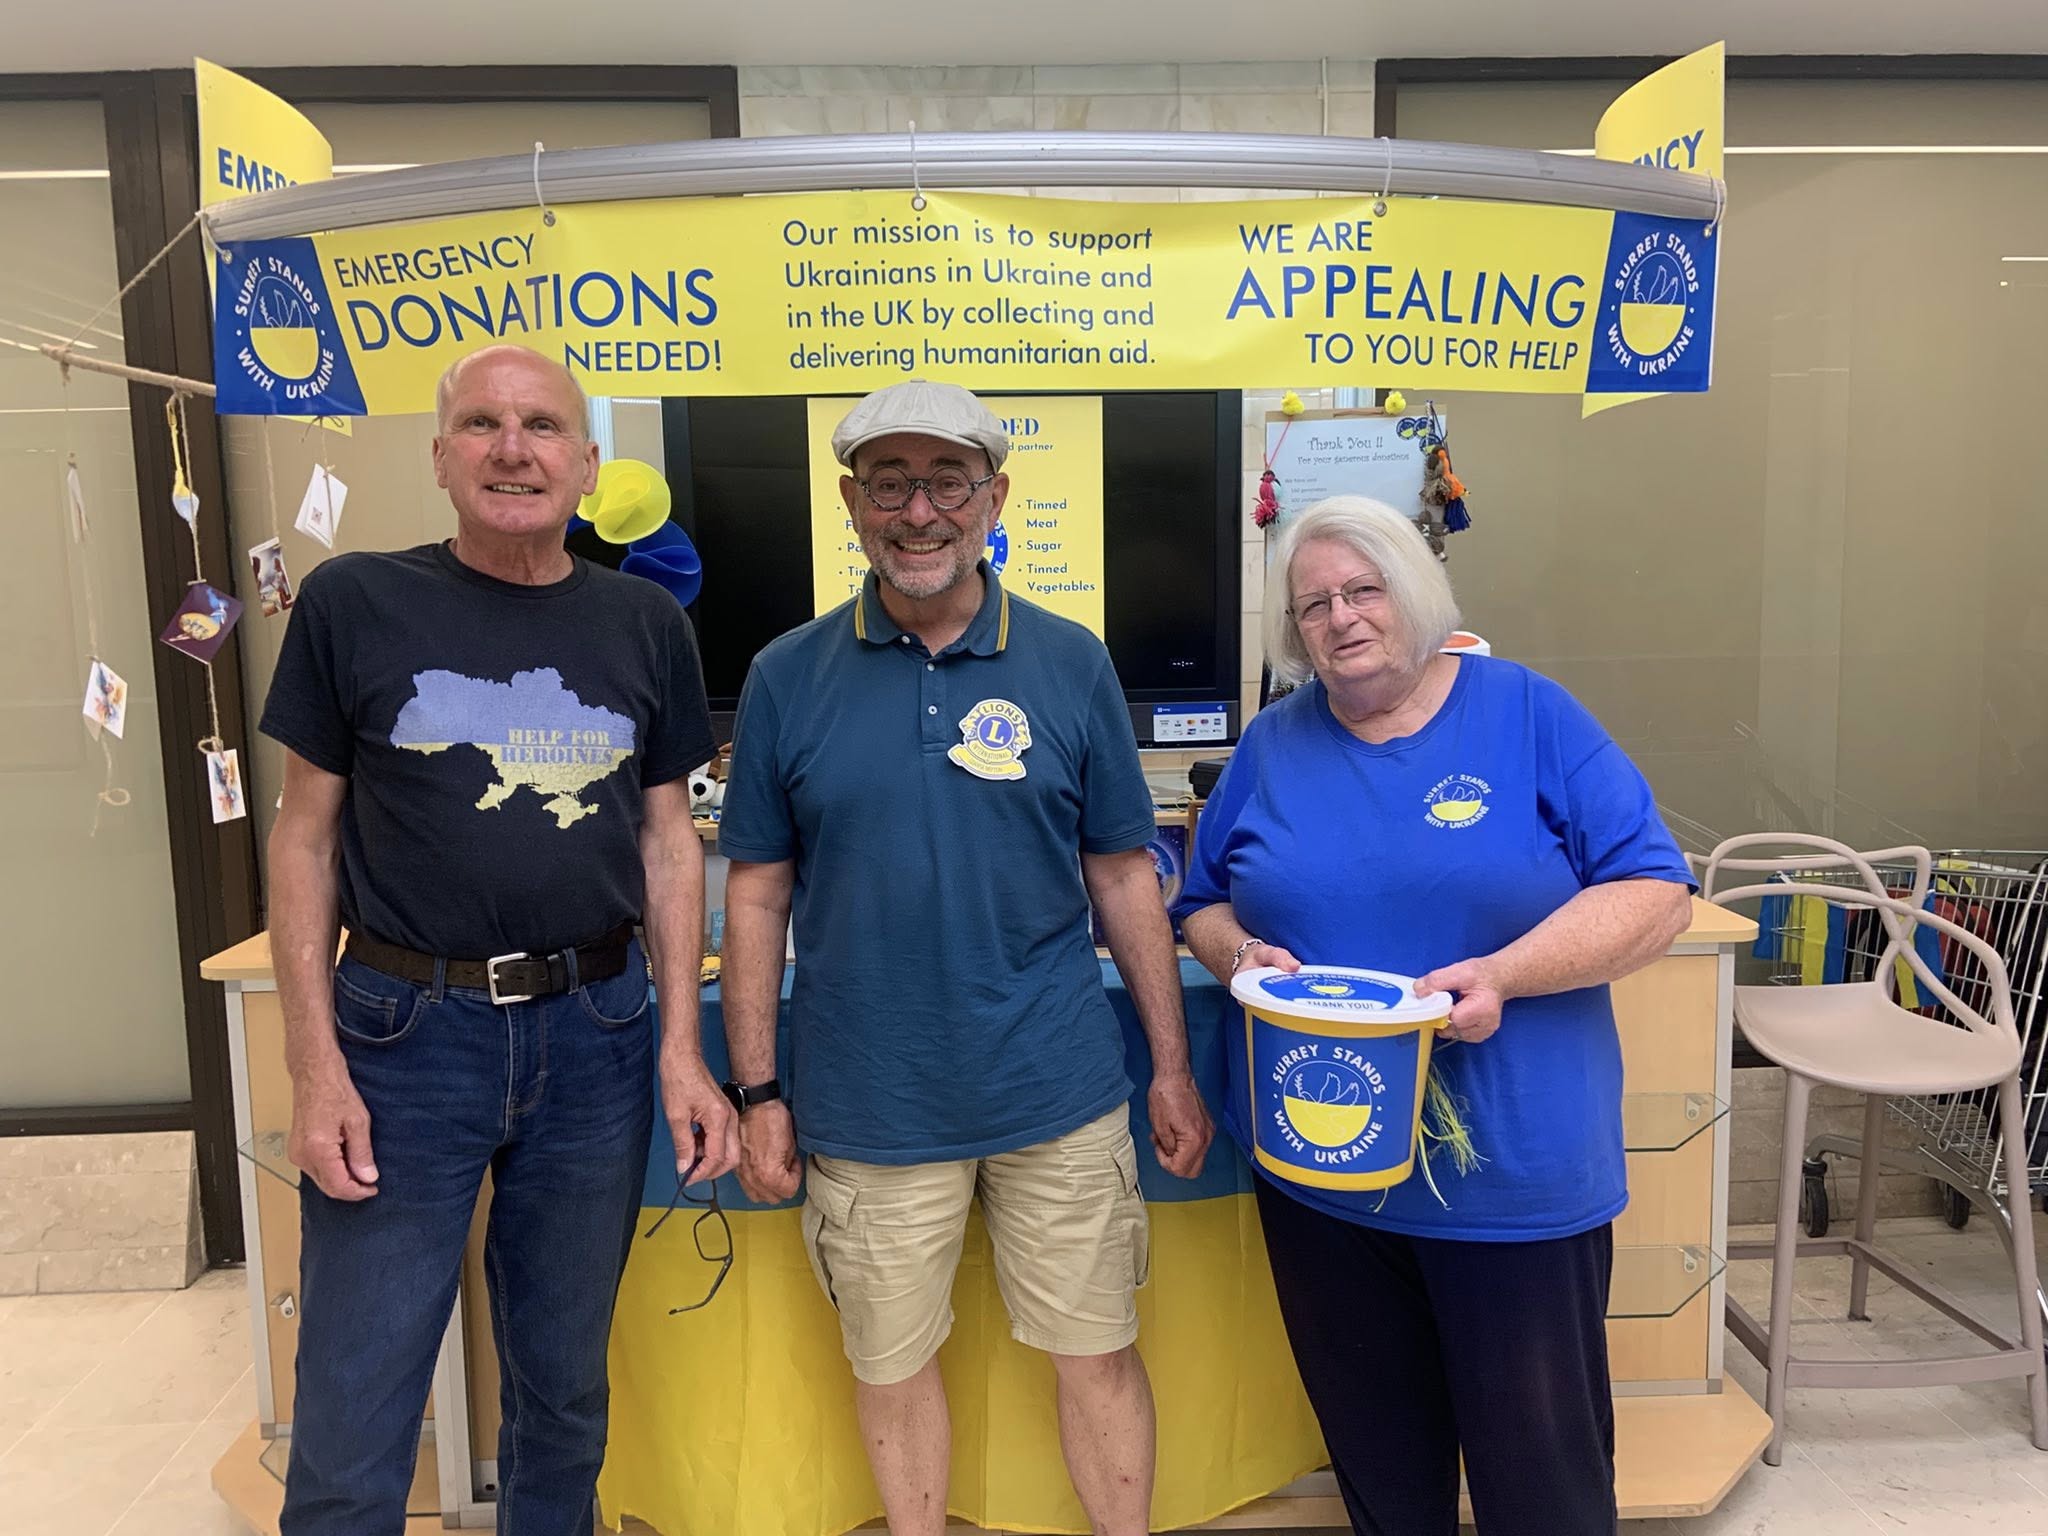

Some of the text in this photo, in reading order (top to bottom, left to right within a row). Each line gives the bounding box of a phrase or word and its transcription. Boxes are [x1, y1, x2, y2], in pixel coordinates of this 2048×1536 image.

[783, 217, 1153, 256] Our mission is to support
[1239, 221, 1373, 254] WE ARE
[333, 232, 536, 288] EMERGENCY
[785, 257, 1152, 288] Ukrainians in Ukraine and
[1615, 232, 1699, 293] SURREY STANDS
[234, 256, 321, 317] SURREY STANDS
[1225, 264, 1586, 329] APPEALING
[347, 268, 718, 351] DONATIONS
[787, 298, 1154, 331] in the UK by collecting and
[565, 340, 722, 372] NEEDED!
[790, 338, 1156, 371] delivering humanitarian aid.
[1305, 333, 1579, 371] TO YOU FOR HELP
[1608, 323, 1695, 376] WITH UKRAINE
[237, 347, 334, 400] WITH UKRAINE
[1018, 443, 1054, 452] partner
[1308, 437, 1343, 451] Thank
[1347, 437, 1372, 449] You
[1026, 499, 1067, 510] Tinned
[1026, 519, 1058, 528] Meat
[1026, 540, 1062, 552] Sugar
[1027, 563, 1068, 574] Tinned
[1027, 581, 1096, 594] Vegetables
[982, 703, 1021, 722] LIONS
[508, 728, 611, 746] HELP FOR
[986, 719, 1004, 745] L
[501, 746, 614, 765] HEROINES
[1423, 773, 1492, 803] SURREY STANDS
[1424, 805, 1490, 829] WITH UKRAINE
[1307, 1000, 1374, 1010] THANK YOU!
[1272, 1044, 1386, 1095] SURREY STANDS
[1274, 1109, 1383, 1164] WITH UKRAINE
